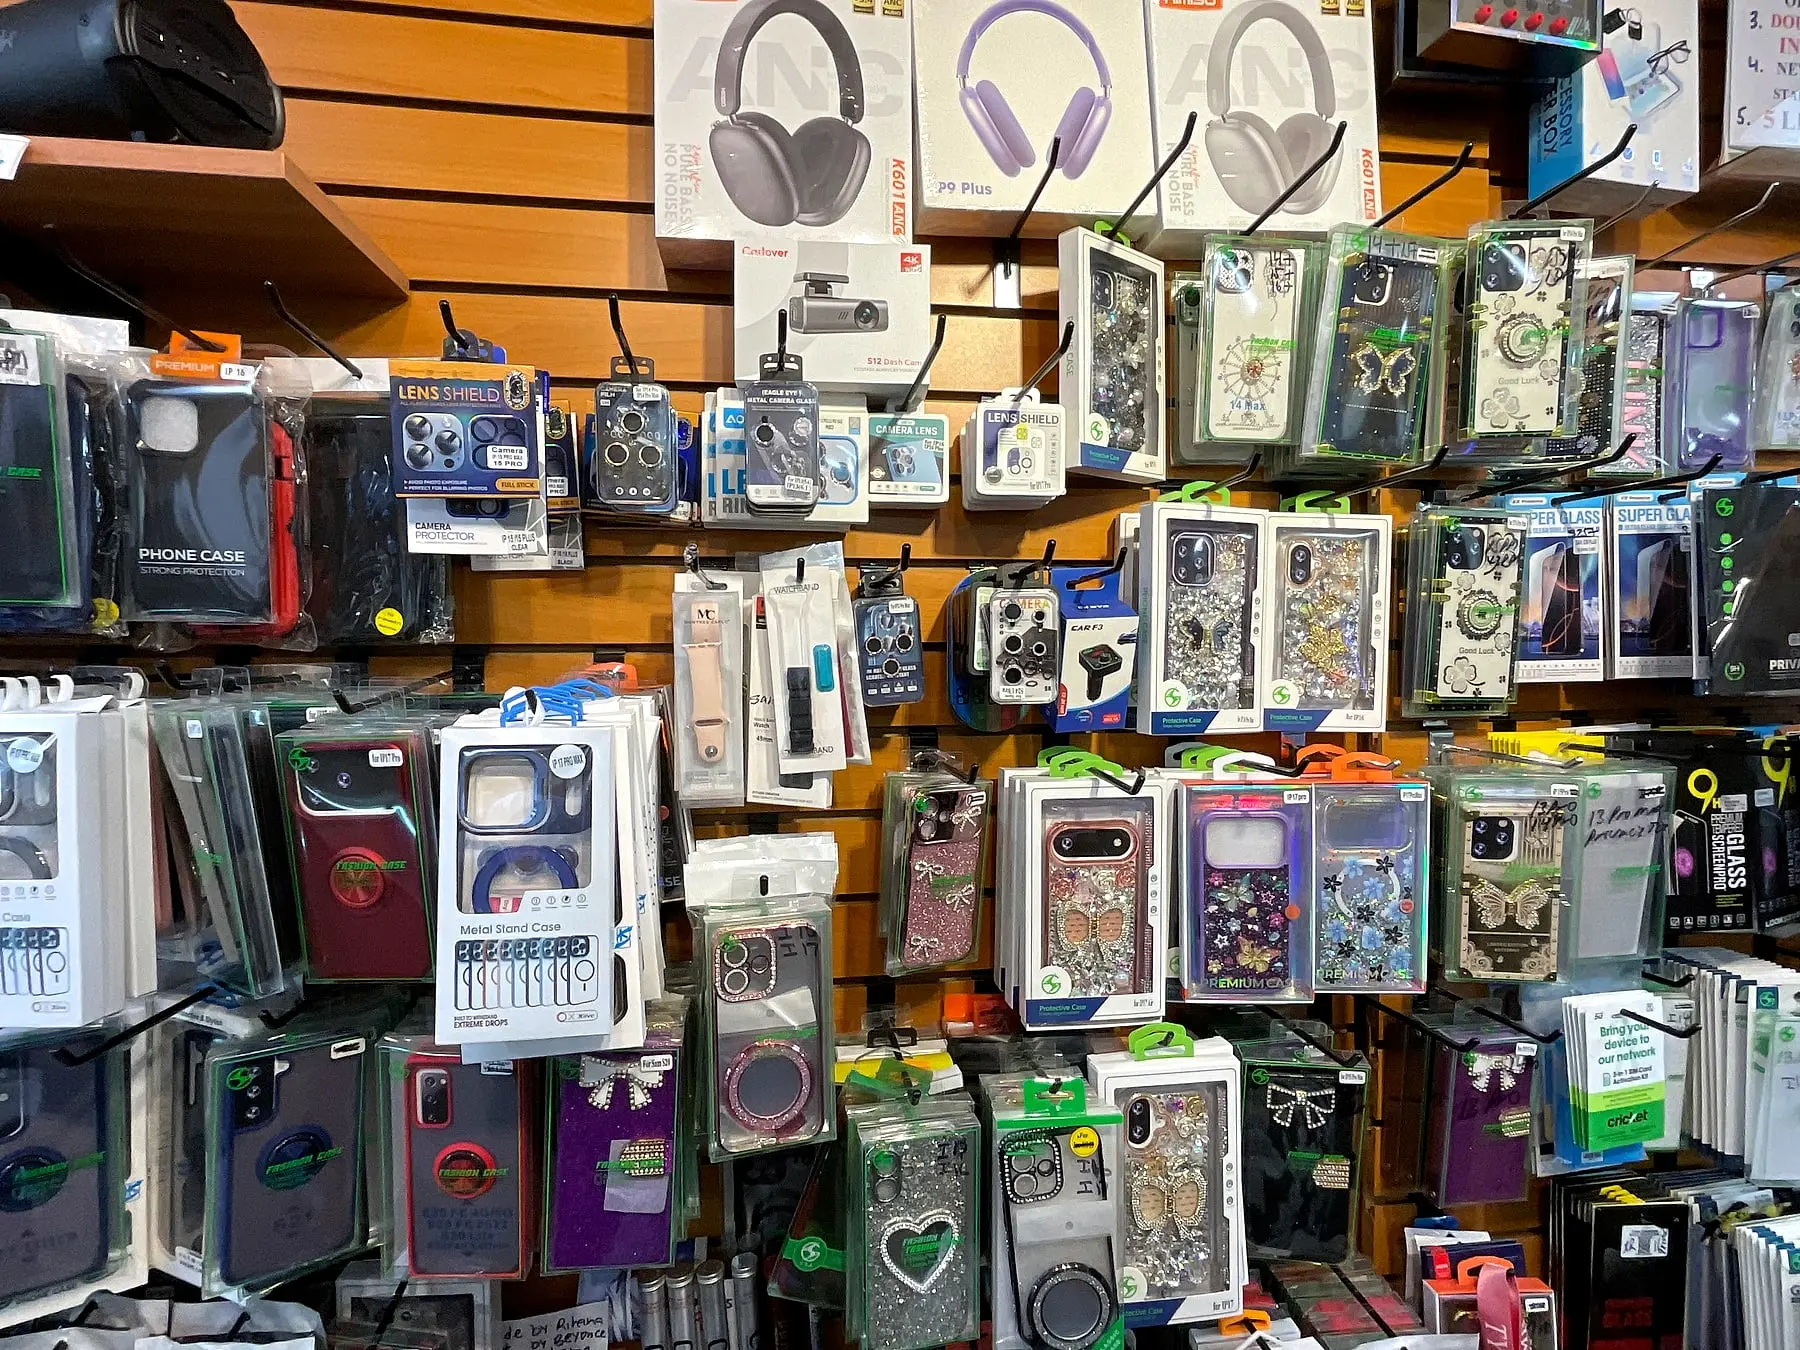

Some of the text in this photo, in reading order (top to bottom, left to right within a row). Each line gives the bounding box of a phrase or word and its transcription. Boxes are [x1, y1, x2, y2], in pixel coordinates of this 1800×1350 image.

[1777, 62, 1800, 75] NE
[1361, 148, 1375, 188] K601
[892, 158, 905, 199] K601
[938, 181, 992, 195] P9 Plus
[903, 255, 919, 264] 4K
[155, 360, 215, 373] PREMIUM
[867, 357, 882, 365] S12
[884, 358, 902, 366] Dash
[1498, 376, 1540, 385] Good Luck
[399, 384, 500, 402] LENS SHIELD
[1230, 400, 1242, 410] 14
[987, 412, 1059, 425] LENS SHIELD
[875, 425, 938, 436] CAMERA LENS
[491, 446, 523, 454] Camera
[1560, 510, 1600, 524] GLASS
[1617, 508, 1662, 522] SUPER
[415, 522, 451, 531] CAMERA
[415, 532, 475, 541] PROTECTOR
[139, 548, 245, 563] PHONE CASE
[140, 566, 245, 577] STRONG PROTECTION
[1091, 623, 1103, 631] F3
[1459, 647, 1495, 655] Good Luck
[1162, 717, 1187, 725] Protective
[1269, 714, 1299, 722] Protective
[564, 756, 574, 768] PRO
[574, 755, 584, 767] MAX
[336, 861, 407, 872] FASHION CASE
[1712, 834, 1726, 890] SCREENPRO
[1727, 833, 1747, 889] GLASS
[460, 922, 561, 935] Metal Stand Case
[1205, 978, 1300, 989] PREMIUM CASE
[454, 1018, 508, 1028] EXTREME DROPS
[1600, 1023, 1650, 1037] Bring you
[1604, 1034, 1650, 1050] device to
[1598, 1046, 1656, 1064] our network
[1639, 1065, 1652, 1073] Card
[1613, 1075, 1641, 1084] Activation
[1607, 1109, 1649, 1128] cricket
[439, 1167, 509, 1178] FASHION CASE
